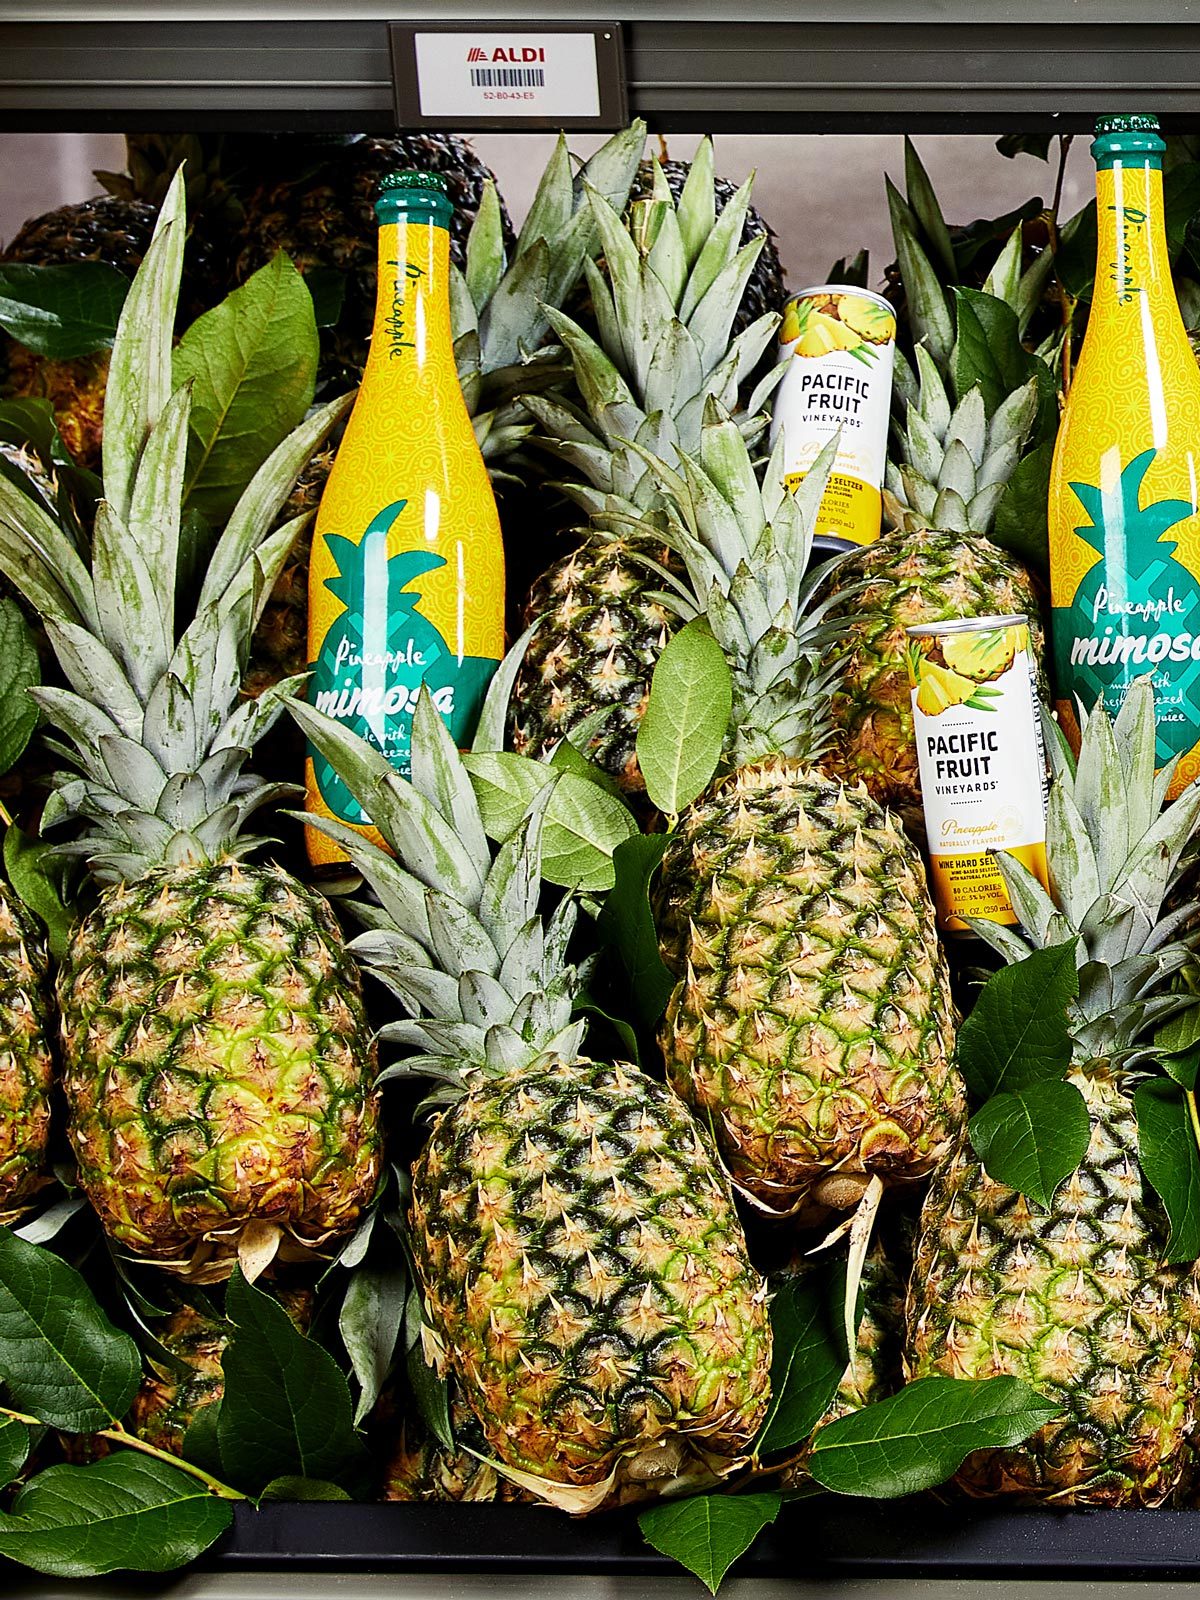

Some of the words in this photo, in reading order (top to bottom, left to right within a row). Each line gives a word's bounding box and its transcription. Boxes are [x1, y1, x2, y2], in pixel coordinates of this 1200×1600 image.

[492, 47, 545, 62] ALDI
[384, 260, 427, 361] Pineapple
[801, 373, 870, 400] PACIFIC
[807, 393, 862, 414] FRUIT
[802, 414, 863, 428] VINEYARDS
[834, 477, 864, 492] SELTZER
[1091, 582, 1187, 624] Pineapple
[333, 633, 427, 676] Pineapple
[315, 677, 455, 719] mimosa
[1155, 708, 1187, 727] juice
[926, 731, 999, 758] PACIFIC
[935, 755, 991, 779] FRUIT
[935, 781, 998, 796] VINEYARDS
[941, 819, 998, 837] Pineapple
[938, 860, 954, 869] WINE
[955, 859, 978, 868] HARD
[962, 883, 1002, 894] CALORIES
